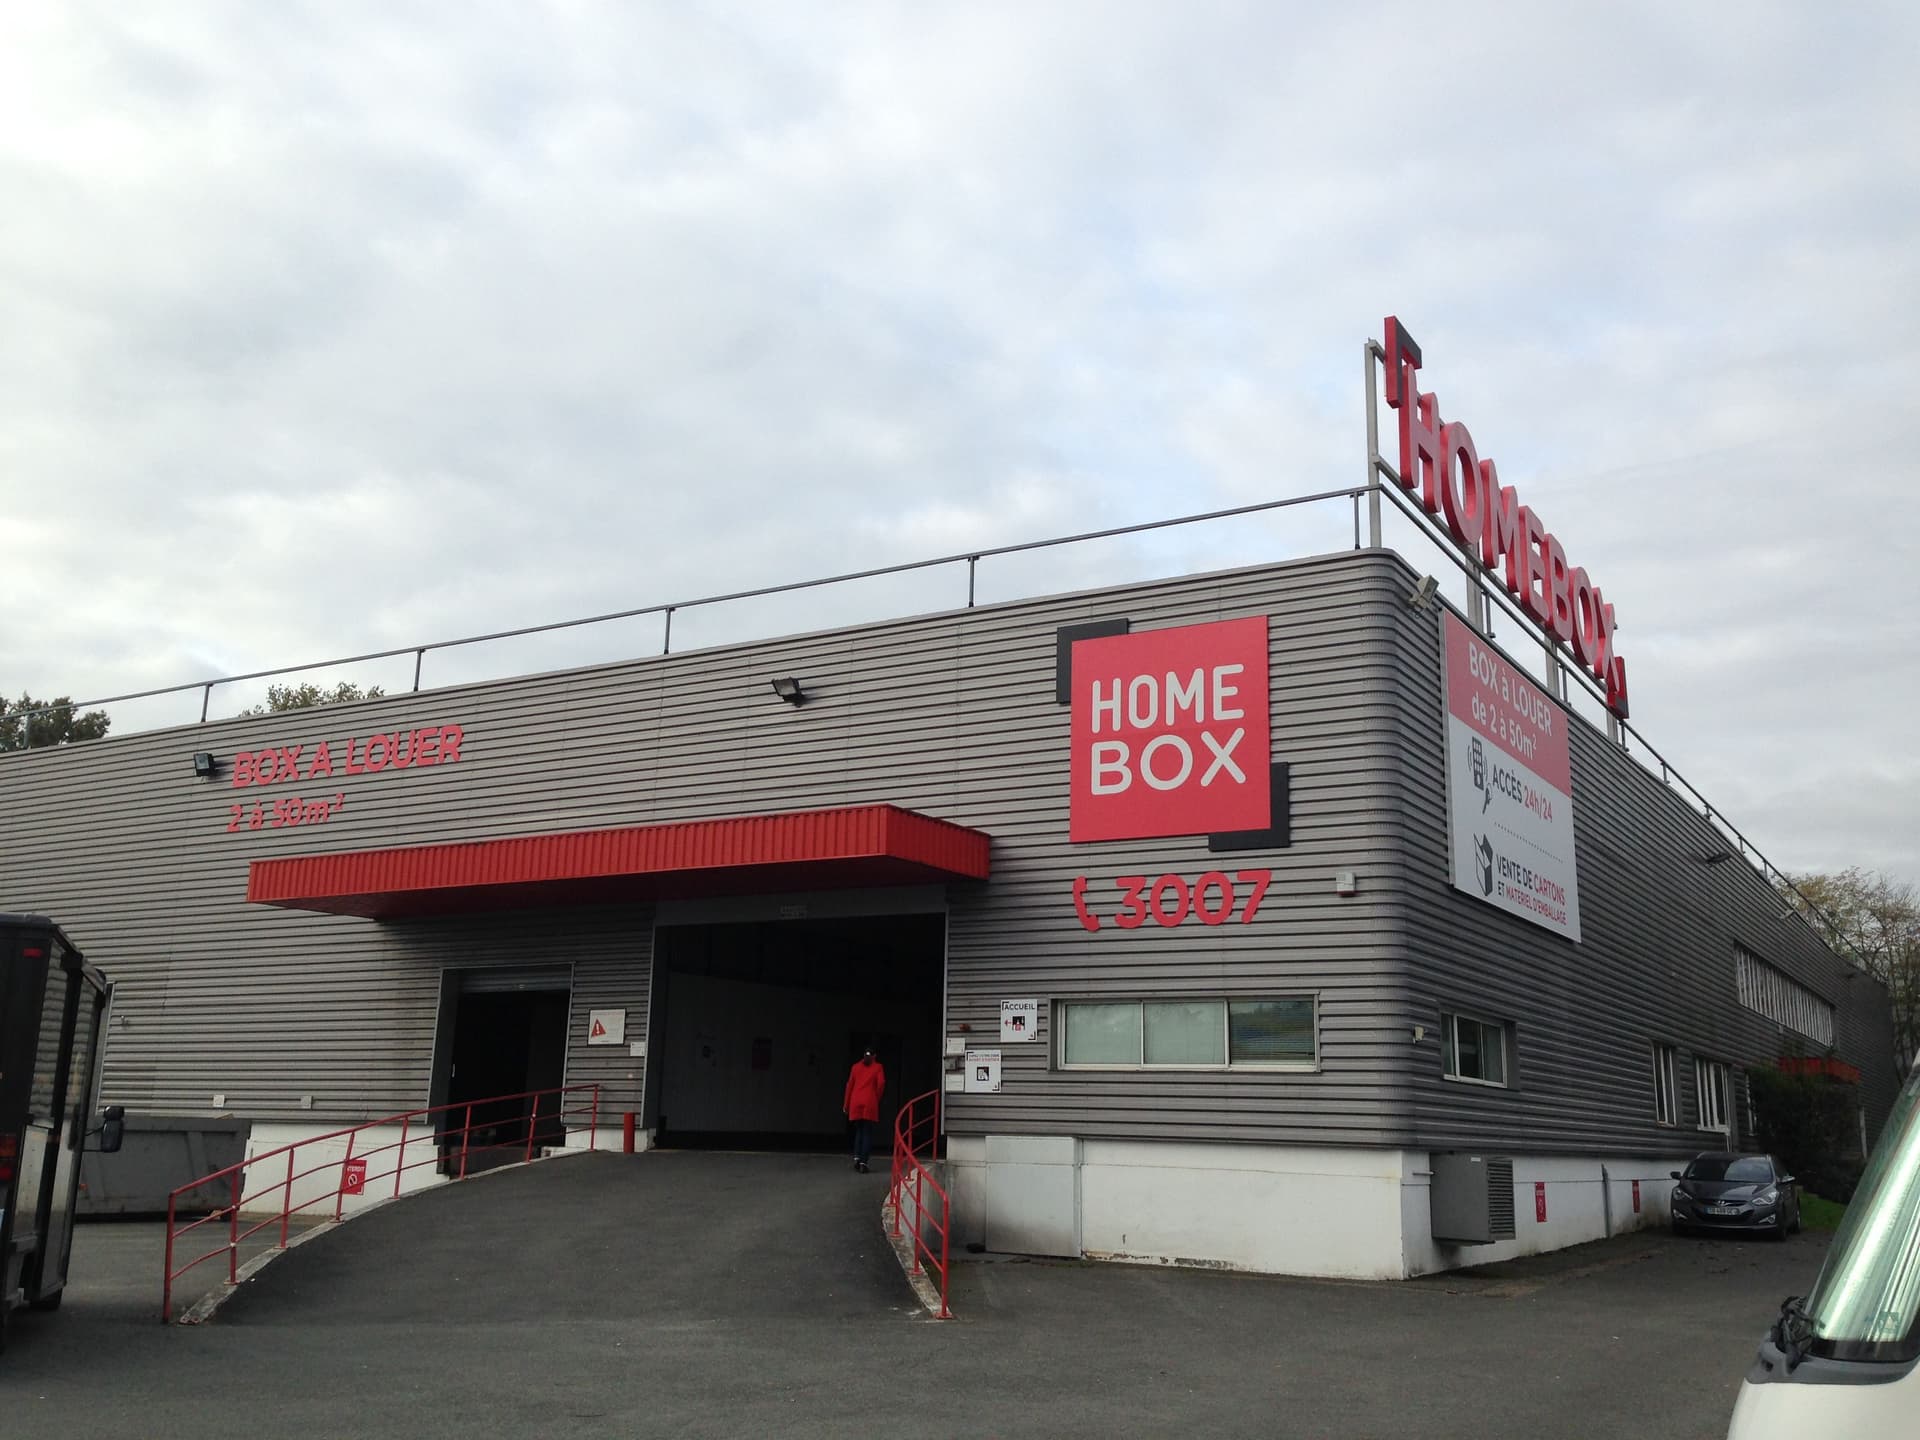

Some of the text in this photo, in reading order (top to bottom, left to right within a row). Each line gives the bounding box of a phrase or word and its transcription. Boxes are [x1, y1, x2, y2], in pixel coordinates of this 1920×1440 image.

[1399, 364, 1620, 693] HOMEBOX
[1091, 663, 1245, 734] HOME
[1468, 641, 1552, 737] BOX à LOUER
[1471, 691, 1487, 726] de
[1489, 703, 1498, 734] 2
[1500, 709, 1507, 741] à
[231, 723, 465, 789] BOX A LOUER
[1090, 727, 1247, 796] BOX
[226, 804, 244, 833] 2
[248, 799, 264, 831] à
[1492, 763, 1553, 823] ACCÈS 24h/24
[1113, 868, 1273, 930] 3007
[1496, 853, 1565, 906] VENTE DE CARTONS
[1003, 1003, 1036, 1011] ACCUEIL
